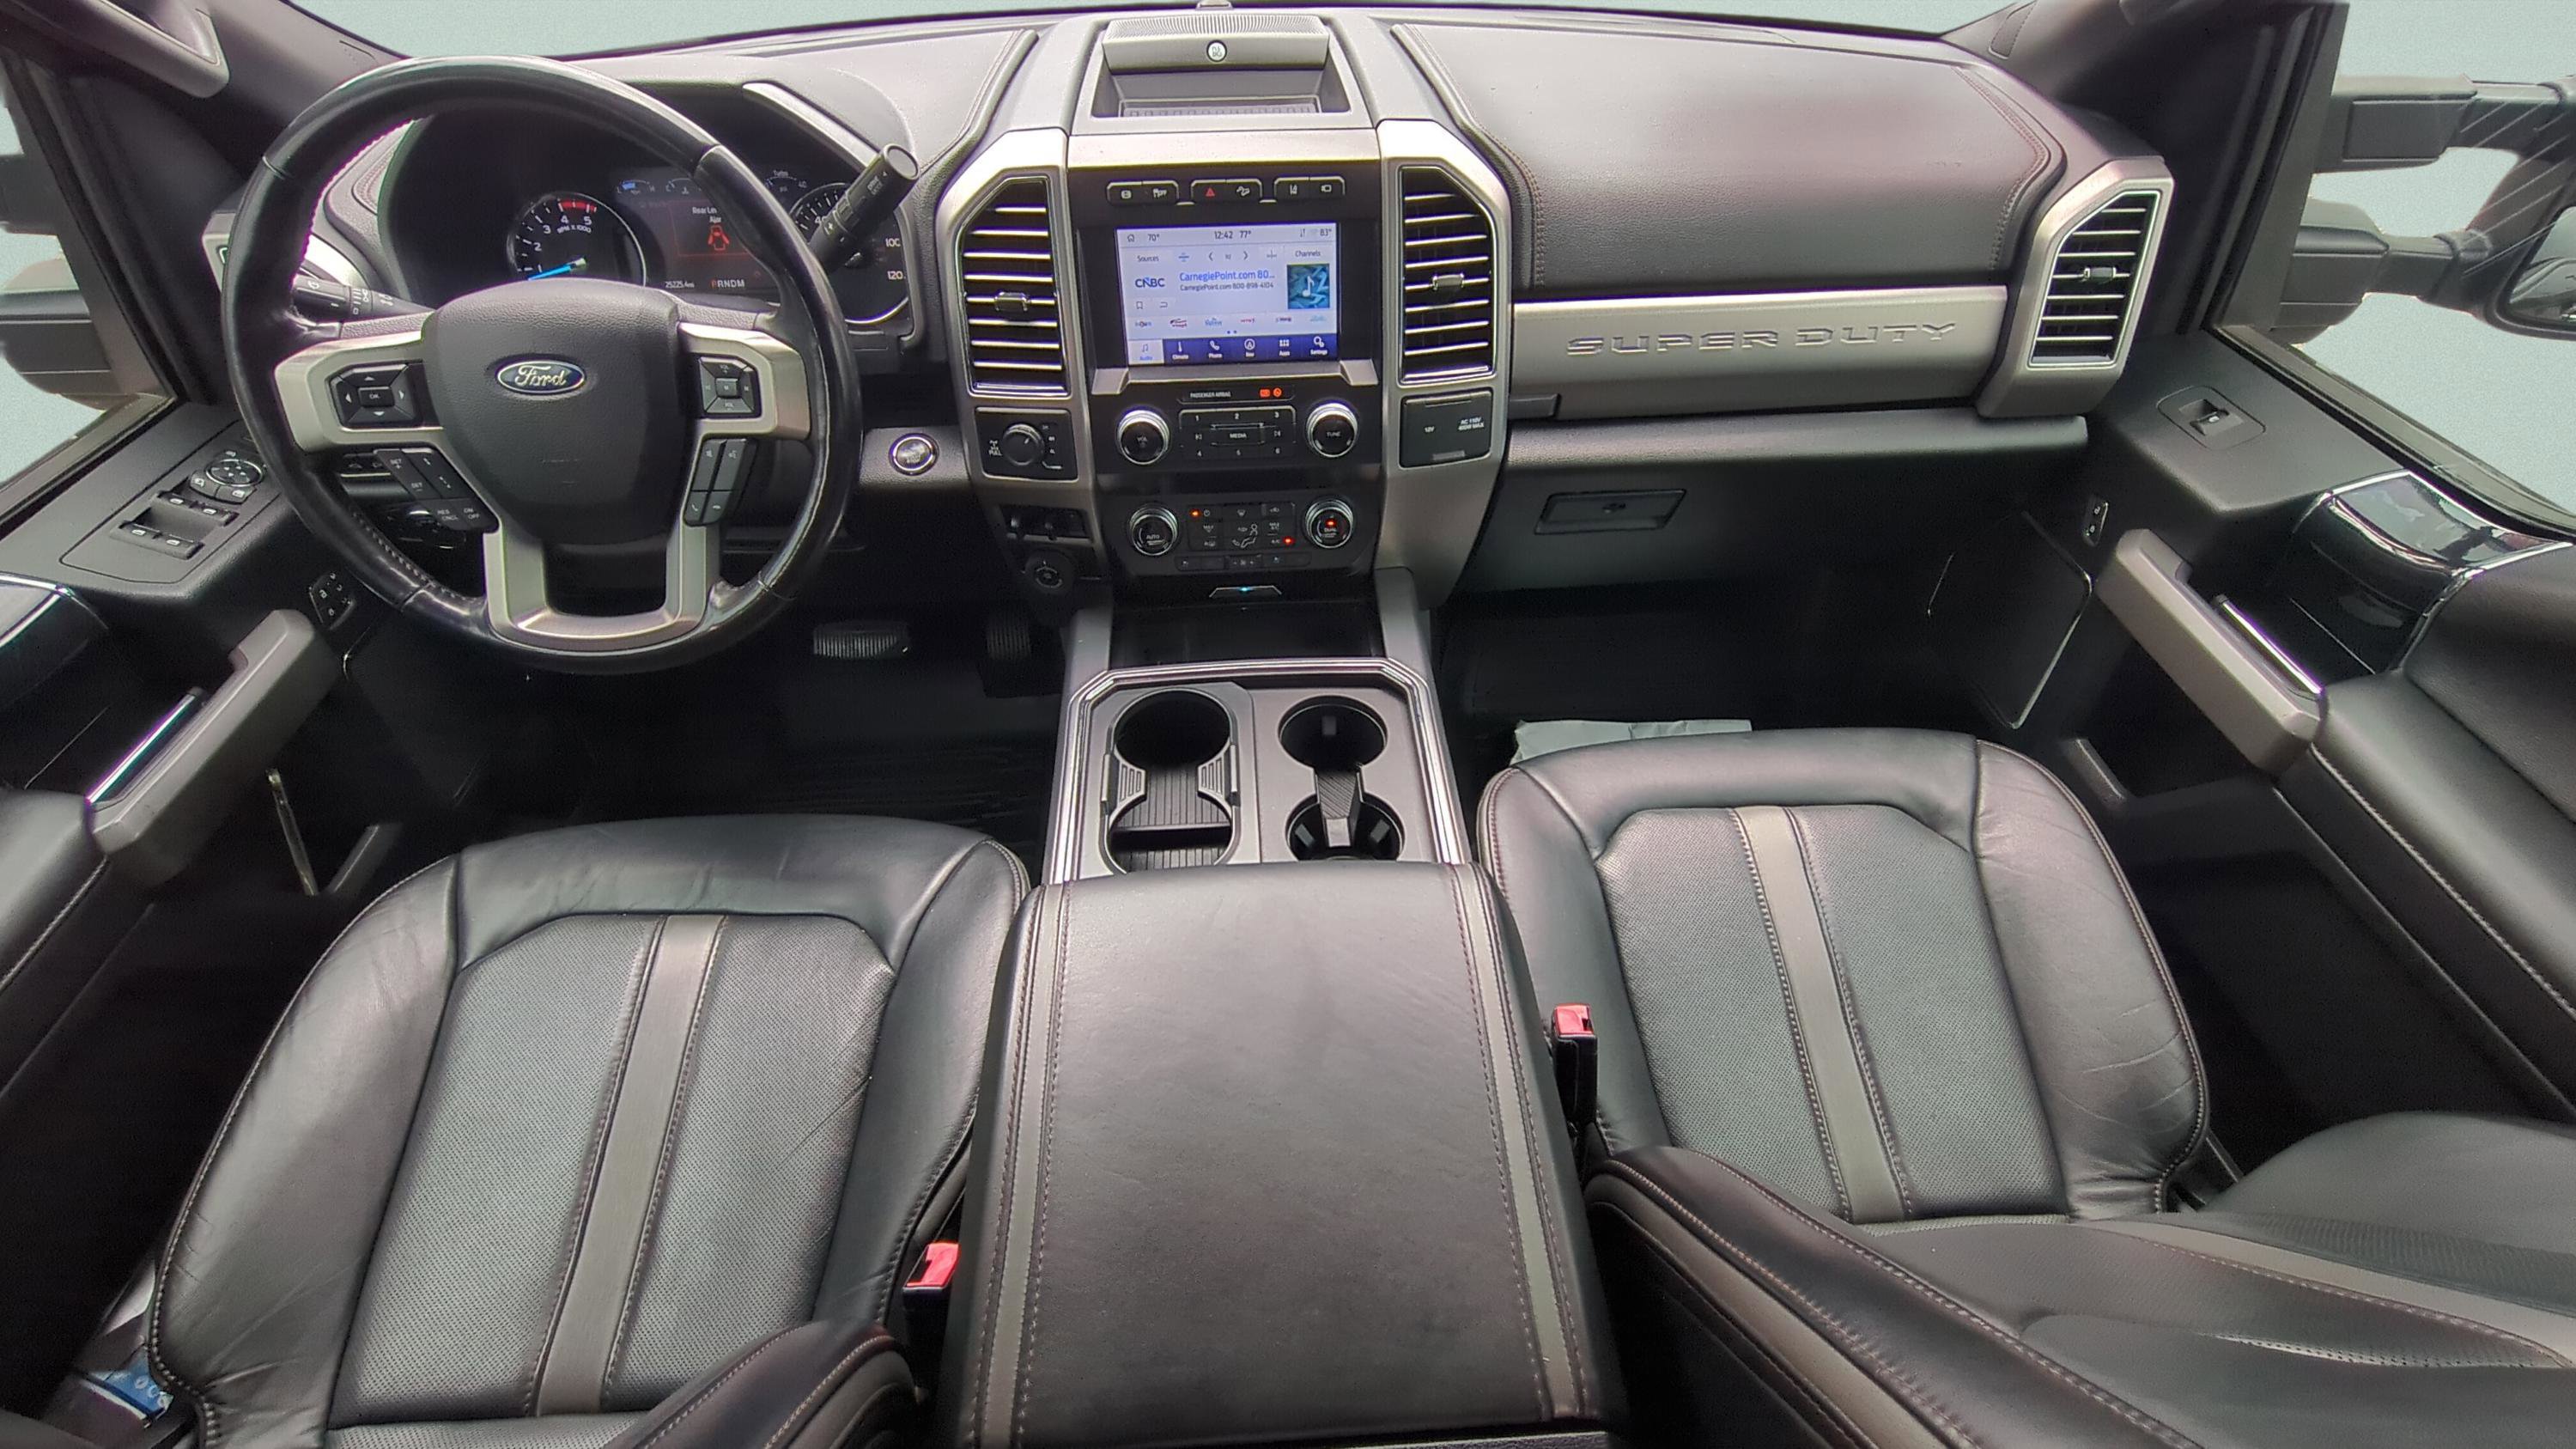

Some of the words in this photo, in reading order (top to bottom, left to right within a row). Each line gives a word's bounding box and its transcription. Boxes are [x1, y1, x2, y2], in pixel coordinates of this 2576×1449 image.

[561, 216, 569, 224] 4
[584, 216, 592, 226] 5
[543, 225, 551, 234] 3
[1214, 231, 1233, 240] 12:42
[533, 242, 542, 252] 2
[888, 271, 903, 280] 120
[1179, 270, 1255, 282] CarnegiePoint.com
[1135, 277, 1165, 288] CNBC
[1566, 330, 1778, 356] SUPER
[1795, 322, 1956, 347] DUTY
[515, 364, 567, 387] Ford
